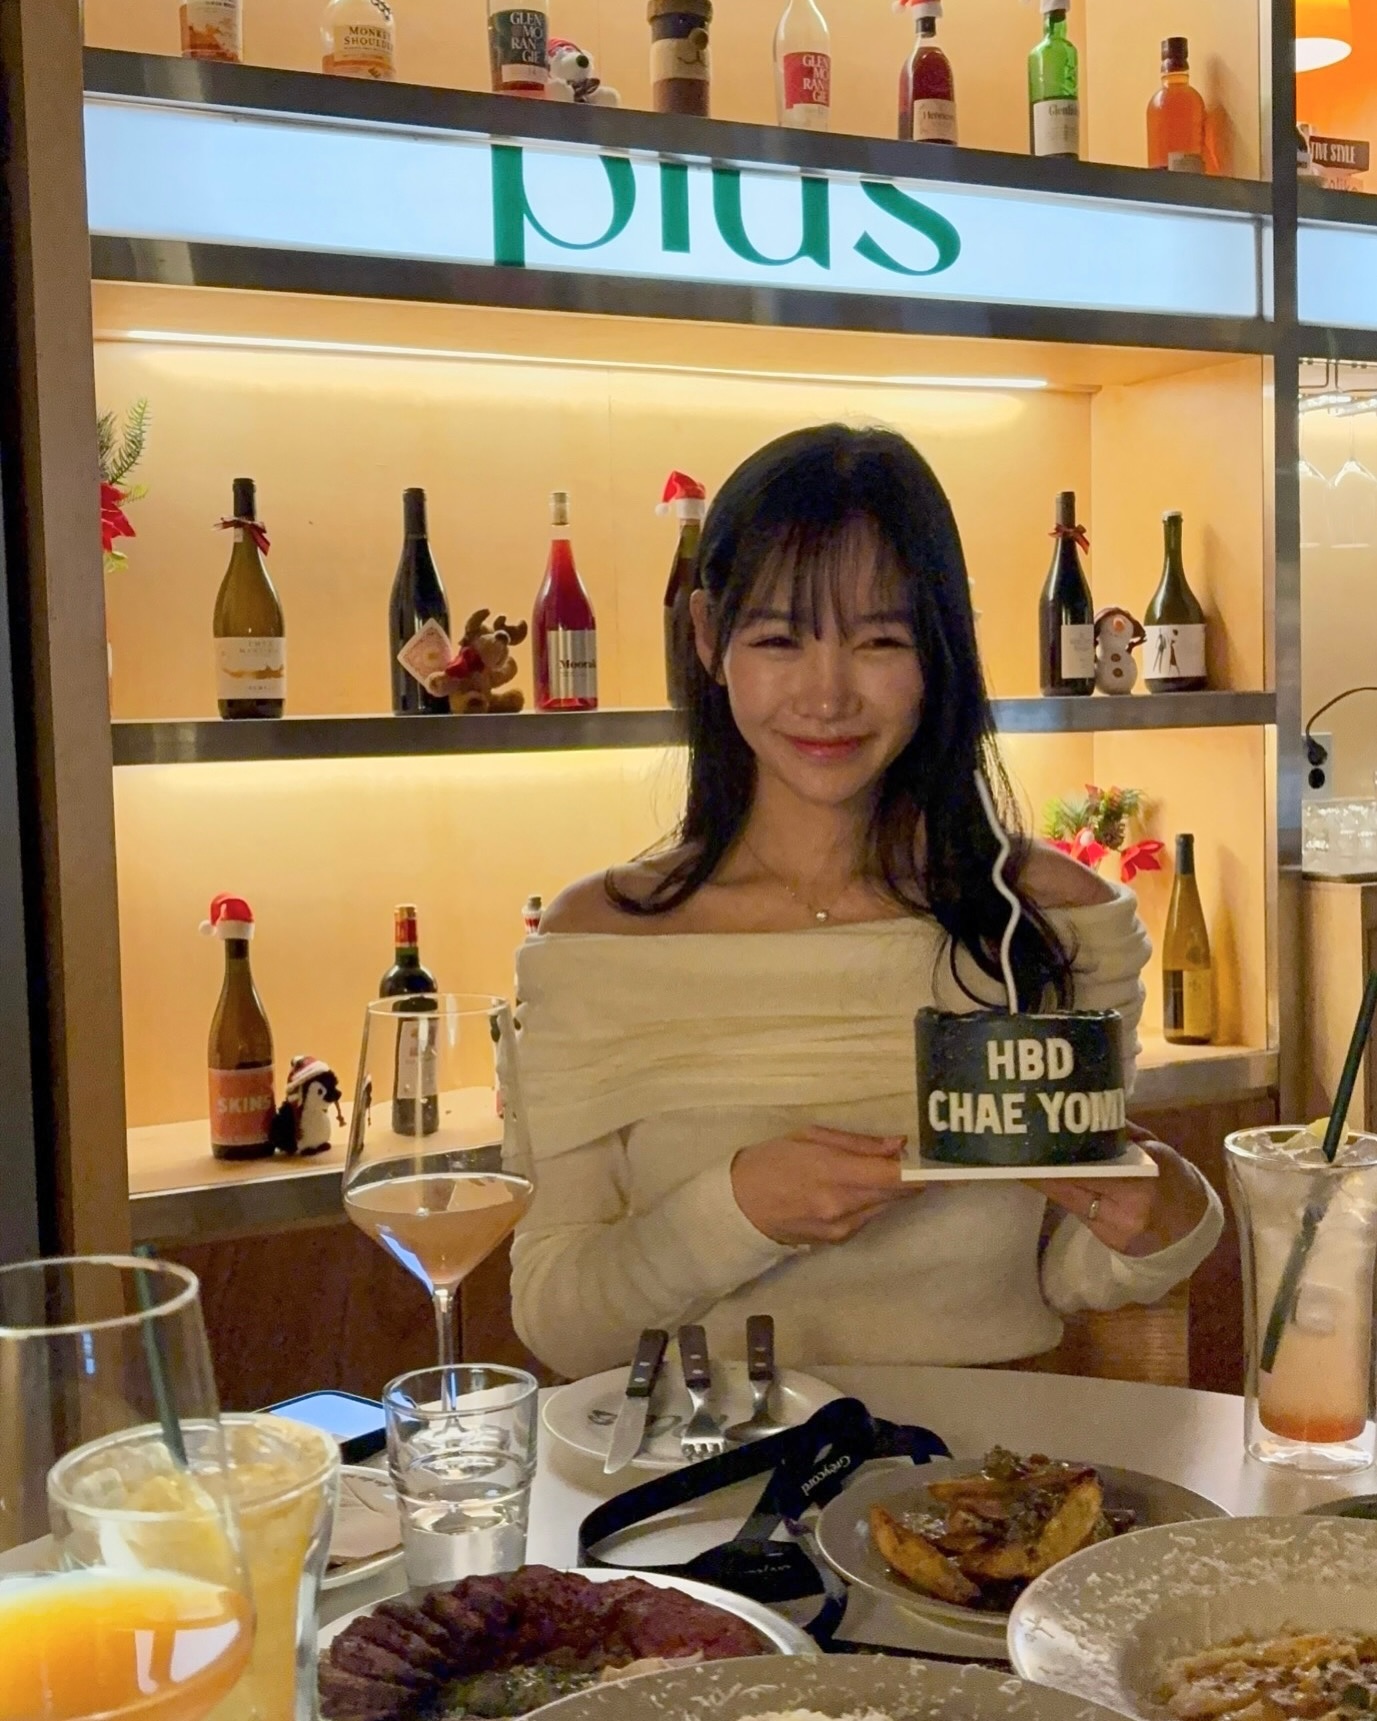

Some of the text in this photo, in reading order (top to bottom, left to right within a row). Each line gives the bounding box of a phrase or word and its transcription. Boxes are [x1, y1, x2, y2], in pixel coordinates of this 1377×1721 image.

[510, 12, 541, 25] GLEN
[523, 25, 543, 39] MO
[511, 37, 537, 50] RAN
[802, 54, 828, 67] GLEN
[802, 77, 824, 91] RAN
[1330, 143, 1356, 164] STYLE
[986, 1037, 1074, 1081] HBD
[928, 1087, 1126, 1135] CHAE YOMI
[801, 1454, 851, 1497] Greycord
